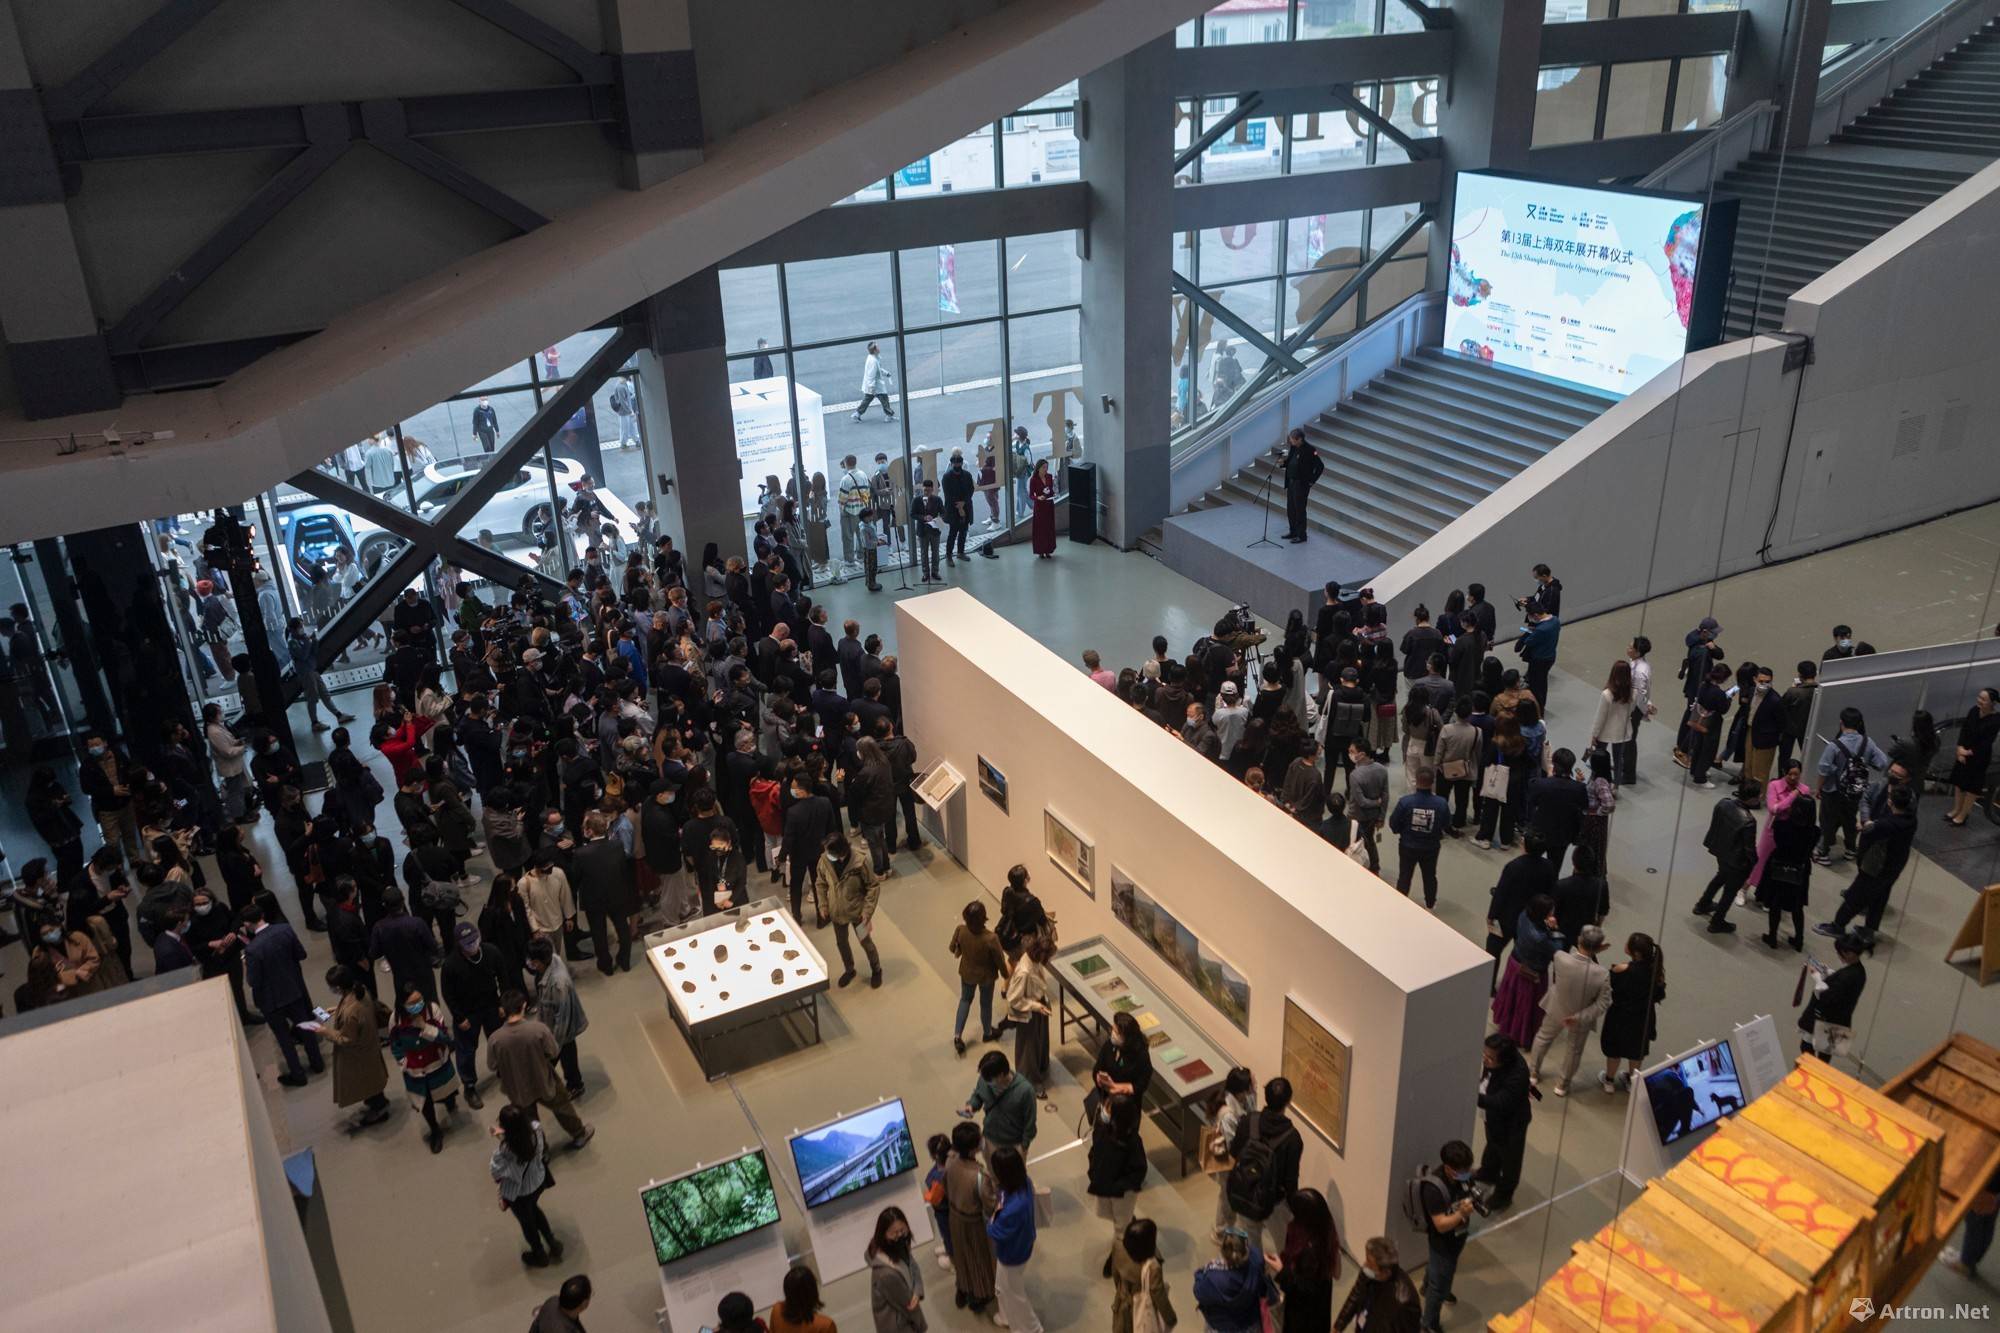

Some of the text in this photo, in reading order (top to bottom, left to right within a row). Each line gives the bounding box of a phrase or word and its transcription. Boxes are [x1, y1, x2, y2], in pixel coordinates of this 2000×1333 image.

[1501, 229, 1633, 265] 第13届上海双年展开幕仪式
[1524, 254, 1549, 265] Shanghai
[1550, 258, 1574, 269] Biennale
[1575, 263, 1600, 276] Opening
[1600, 268, 1631, 281] Ceremony
